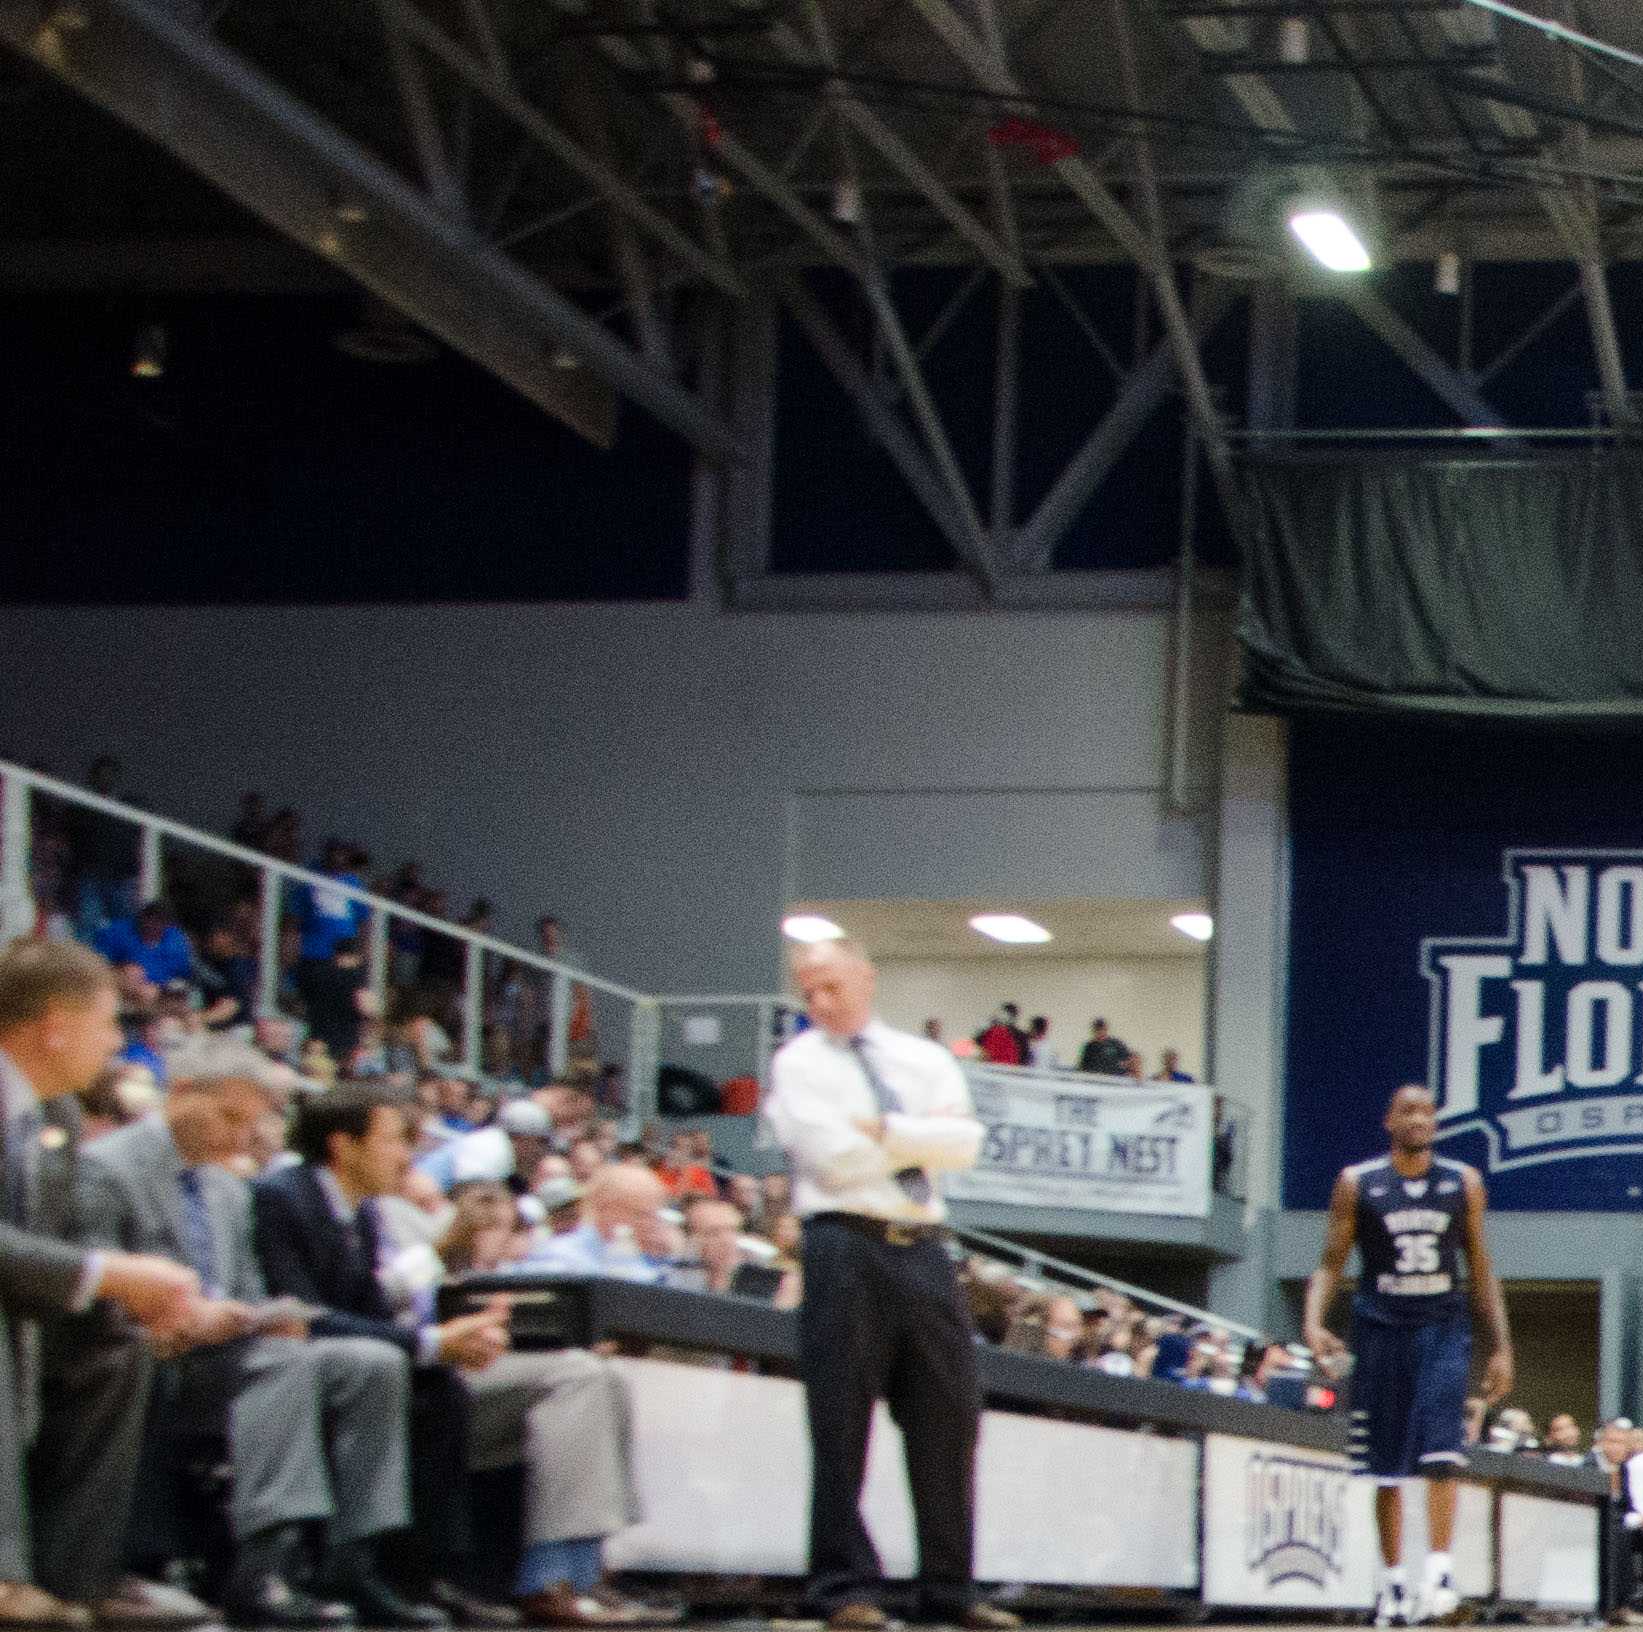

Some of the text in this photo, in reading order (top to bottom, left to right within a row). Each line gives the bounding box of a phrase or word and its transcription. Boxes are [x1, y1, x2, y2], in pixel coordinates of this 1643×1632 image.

[982, 1124, 1178, 1175] SPREY NEST
[1394, 1234, 1439, 1272] 35
